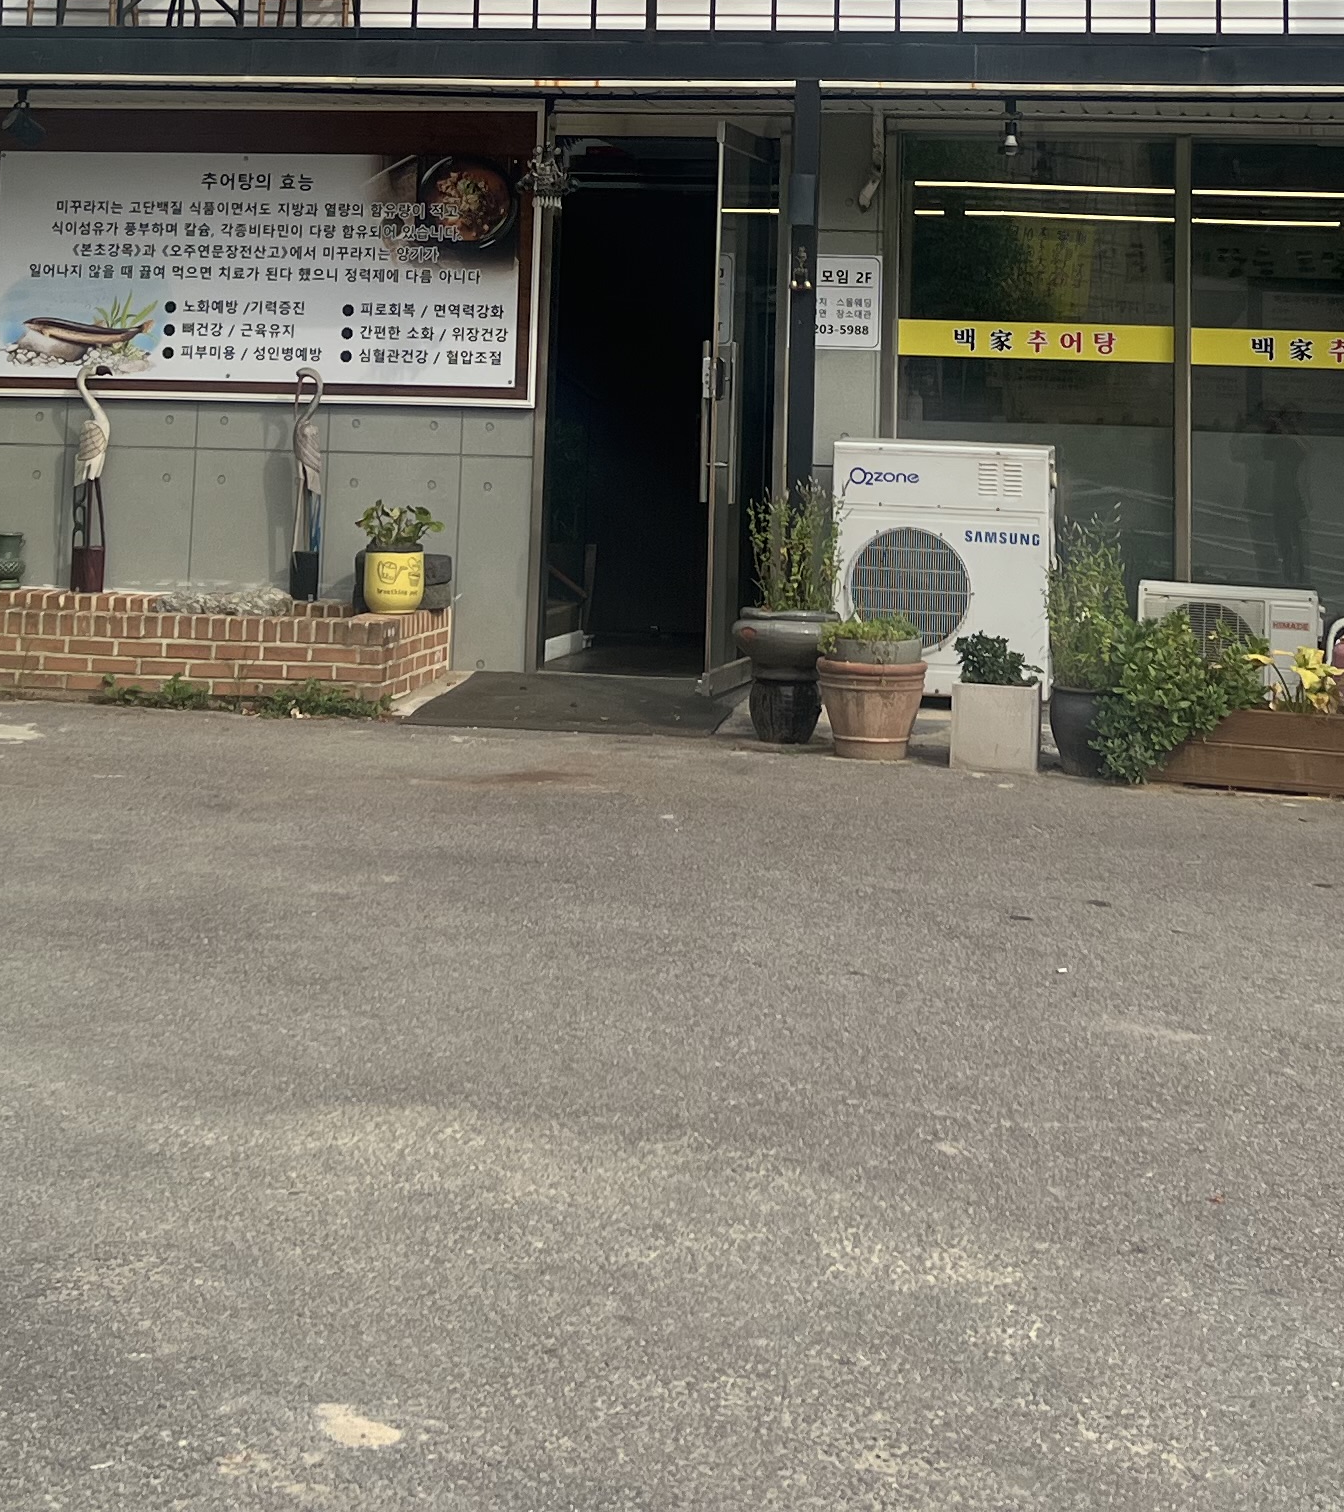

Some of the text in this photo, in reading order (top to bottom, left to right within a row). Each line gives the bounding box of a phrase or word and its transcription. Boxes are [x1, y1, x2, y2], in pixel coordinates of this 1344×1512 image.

[201, 172, 314, 191] 추어탕의 효능
[56, 200, 123, 215] 미꾸라지는
[128, 200, 183, 215] 고단백질
[189, 201, 271, 216] 식품이면서도
[278, 202, 318, 217] 지방과
[324, 202, 364, 217] 열량의
[370, 202, 426, 219] 함유량이
[52, 221, 463, 241] 식이섬유가 풍부하며 칼슘, 각종비타민이 다량 함유되어 있습니다.
[323, 246, 391, 262] 미꾸라지는
[397, 246, 439, 263] 양기가
[29, 263, 83, 278] 일어나지
[88, 264, 114, 279] 않을
[120, 265, 133, 279] 때
[172, 266, 212, 280] 먹으면
[218, 266, 259, 281] 치료가
[265, 267, 292, 282] 된다
[298, 267, 338, 282] 했으니
[344, 268, 399, 283] 정력제에
[406, 268, 432, 283] 다름
[439, 269, 481, 284] 아니다
[821, 269, 873, 284] 모임 2F
[183, 299, 238, 314] 노화예방
[360, 302, 416, 318] 피로회복
[434, 303, 504, 319] 면역력강화
[182, 323, 223, 337] 뼈건강
[240, 324, 295, 339] 근육유지
[360, 325, 401, 340] 간편한
[407, 326, 434, 341] 소화
[452, 327, 508, 343] 위장건강
[1027, 329, 1117, 355] 추어탕
[180, 345, 235, 360] 피부미용
[253, 347, 322, 362] 성인병예방
[359, 349, 428, 364] 심혈관건강
[446, 350, 502, 366] 혈압조절
[964, 530, 1041, 546] SAMSUNG
